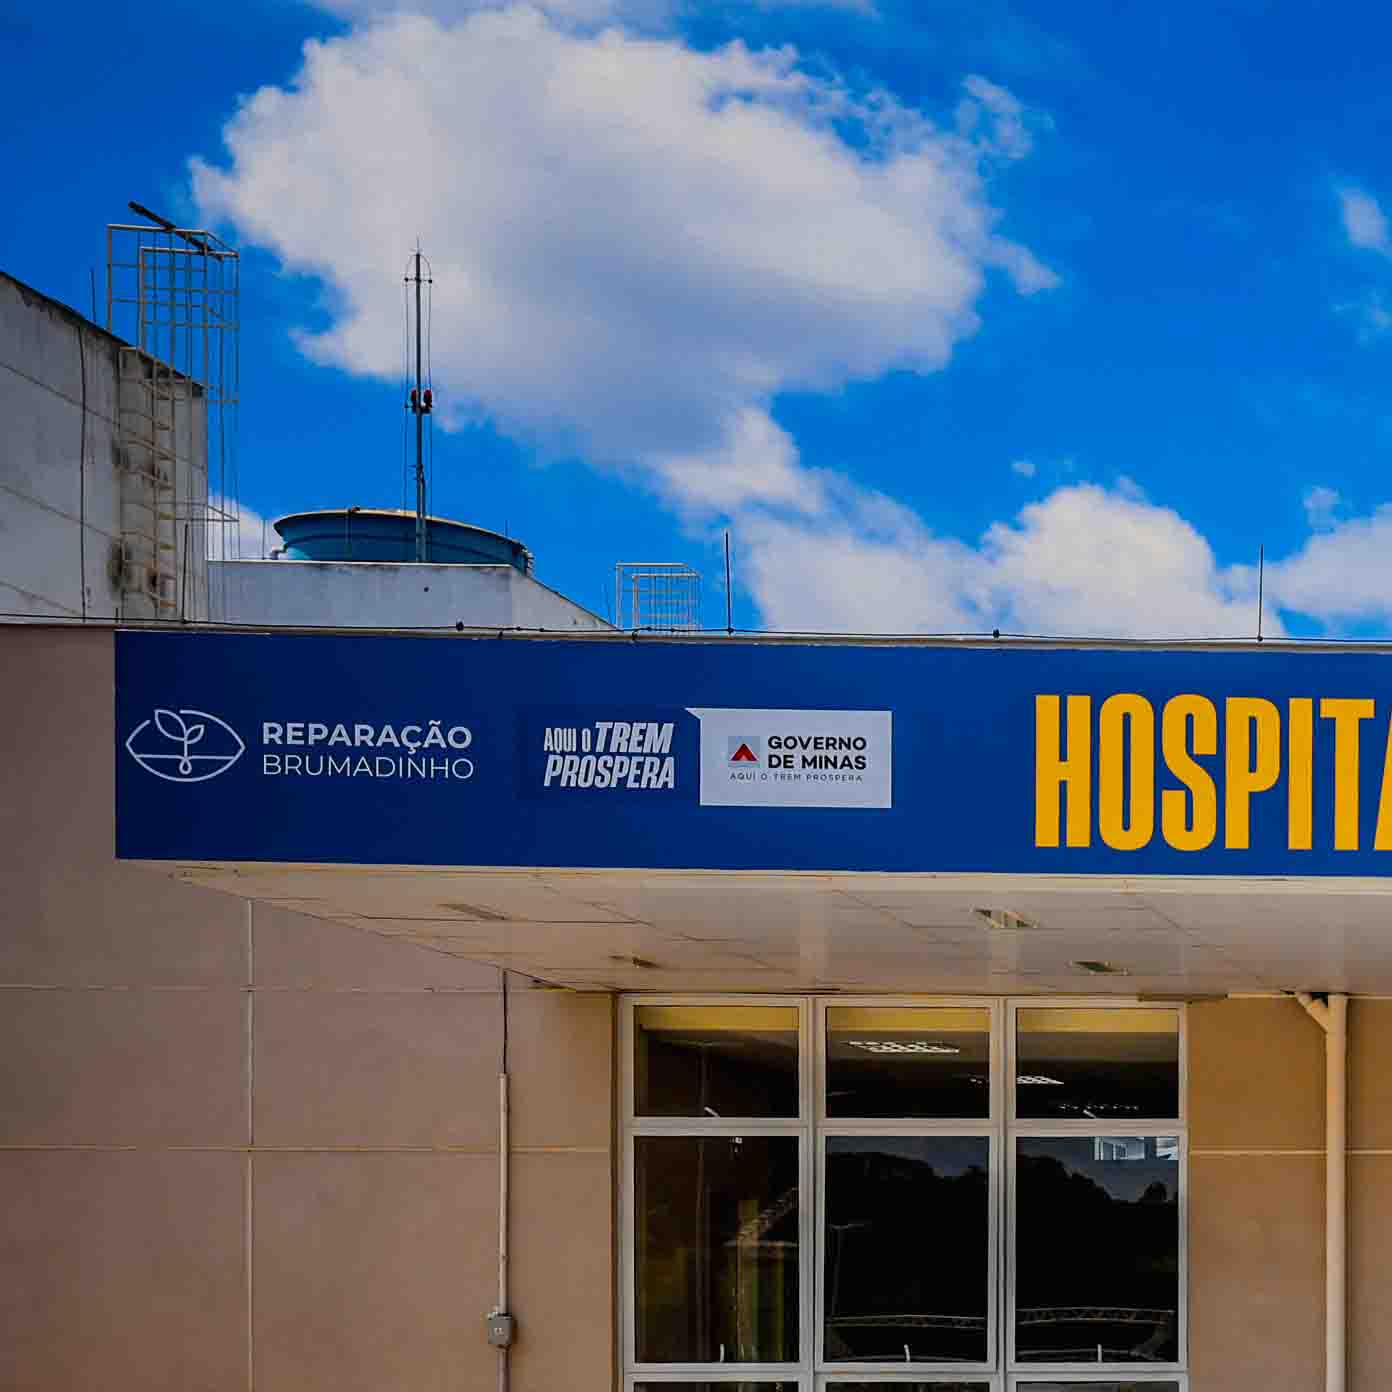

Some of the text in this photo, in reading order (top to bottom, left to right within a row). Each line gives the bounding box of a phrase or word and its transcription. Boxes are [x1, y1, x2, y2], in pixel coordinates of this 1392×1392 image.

[262, 720, 473, 754] REPARAÇÃO
[543, 721, 675, 754] AQUI O TREM
[768, 736, 867, 751] GOVERNO
[263, 754, 474, 779] BRUMADINHO
[543, 754, 676, 789] PROSPERA
[768, 754, 867, 770] DE MINAS
[729, 772, 863, 782] AQUI O TREM PROSPERA
